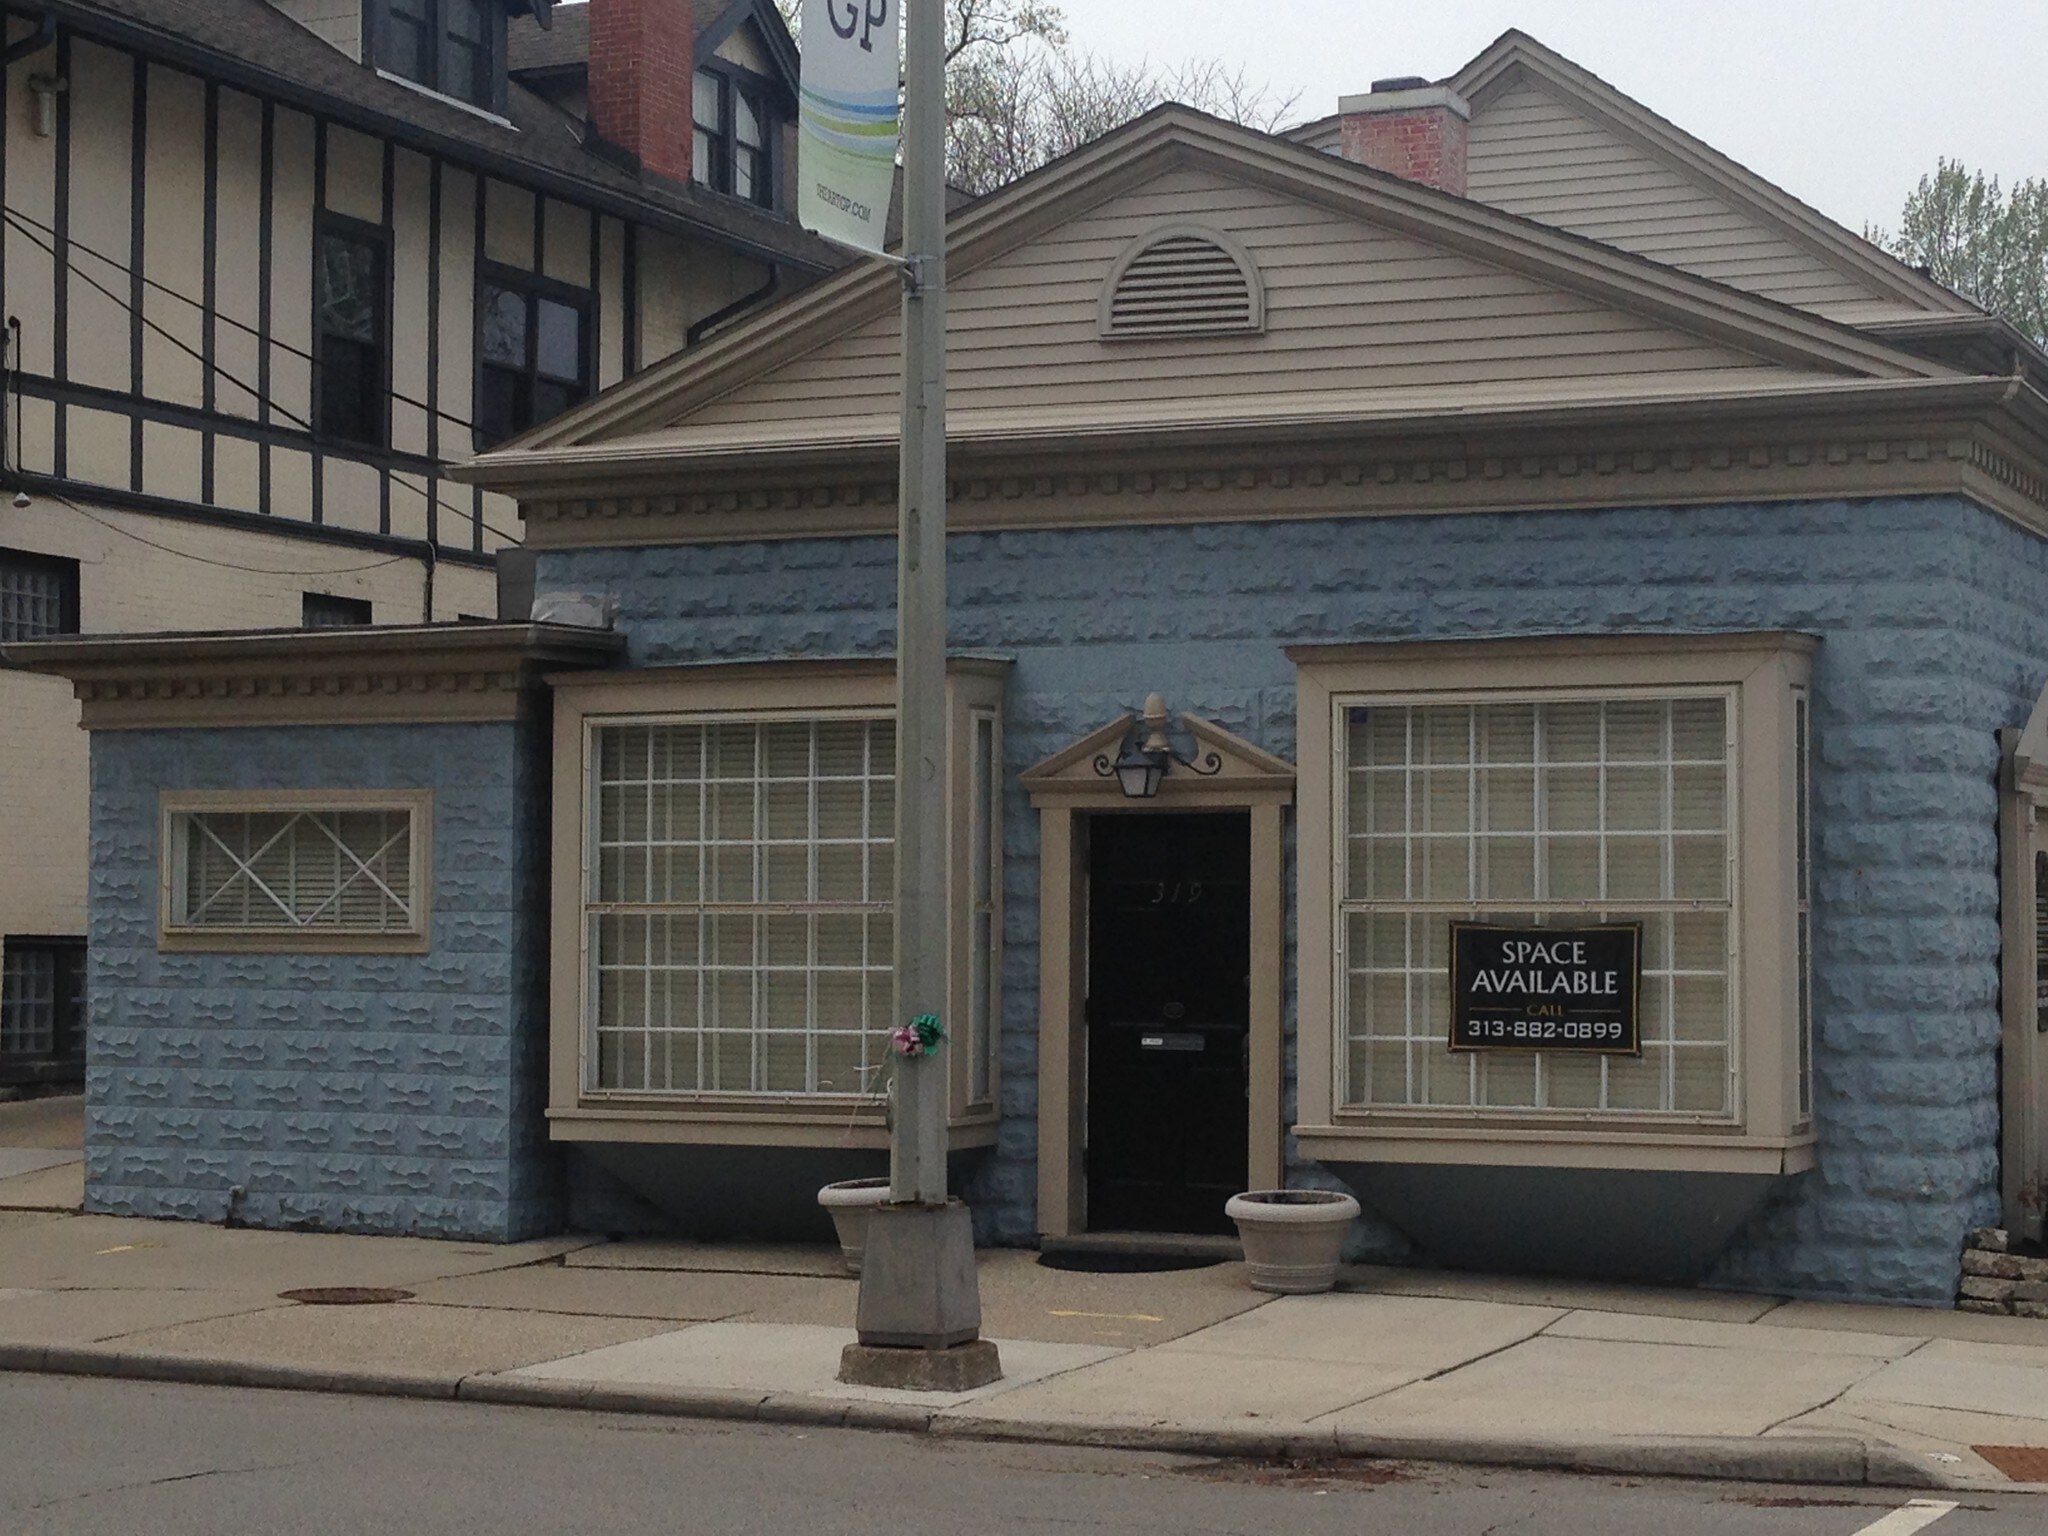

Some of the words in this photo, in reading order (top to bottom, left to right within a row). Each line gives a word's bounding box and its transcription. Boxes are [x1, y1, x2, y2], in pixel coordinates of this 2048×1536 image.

[1151, 882, 1202, 903] 319
[1502, 941, 1587, 964] SPACE
[1470, 969, 1618, 994] AVAILABLE
[1526, 1004, 1564, 1017] CALL
[1468, 1020, 1622, 1039] 313-882-0899
